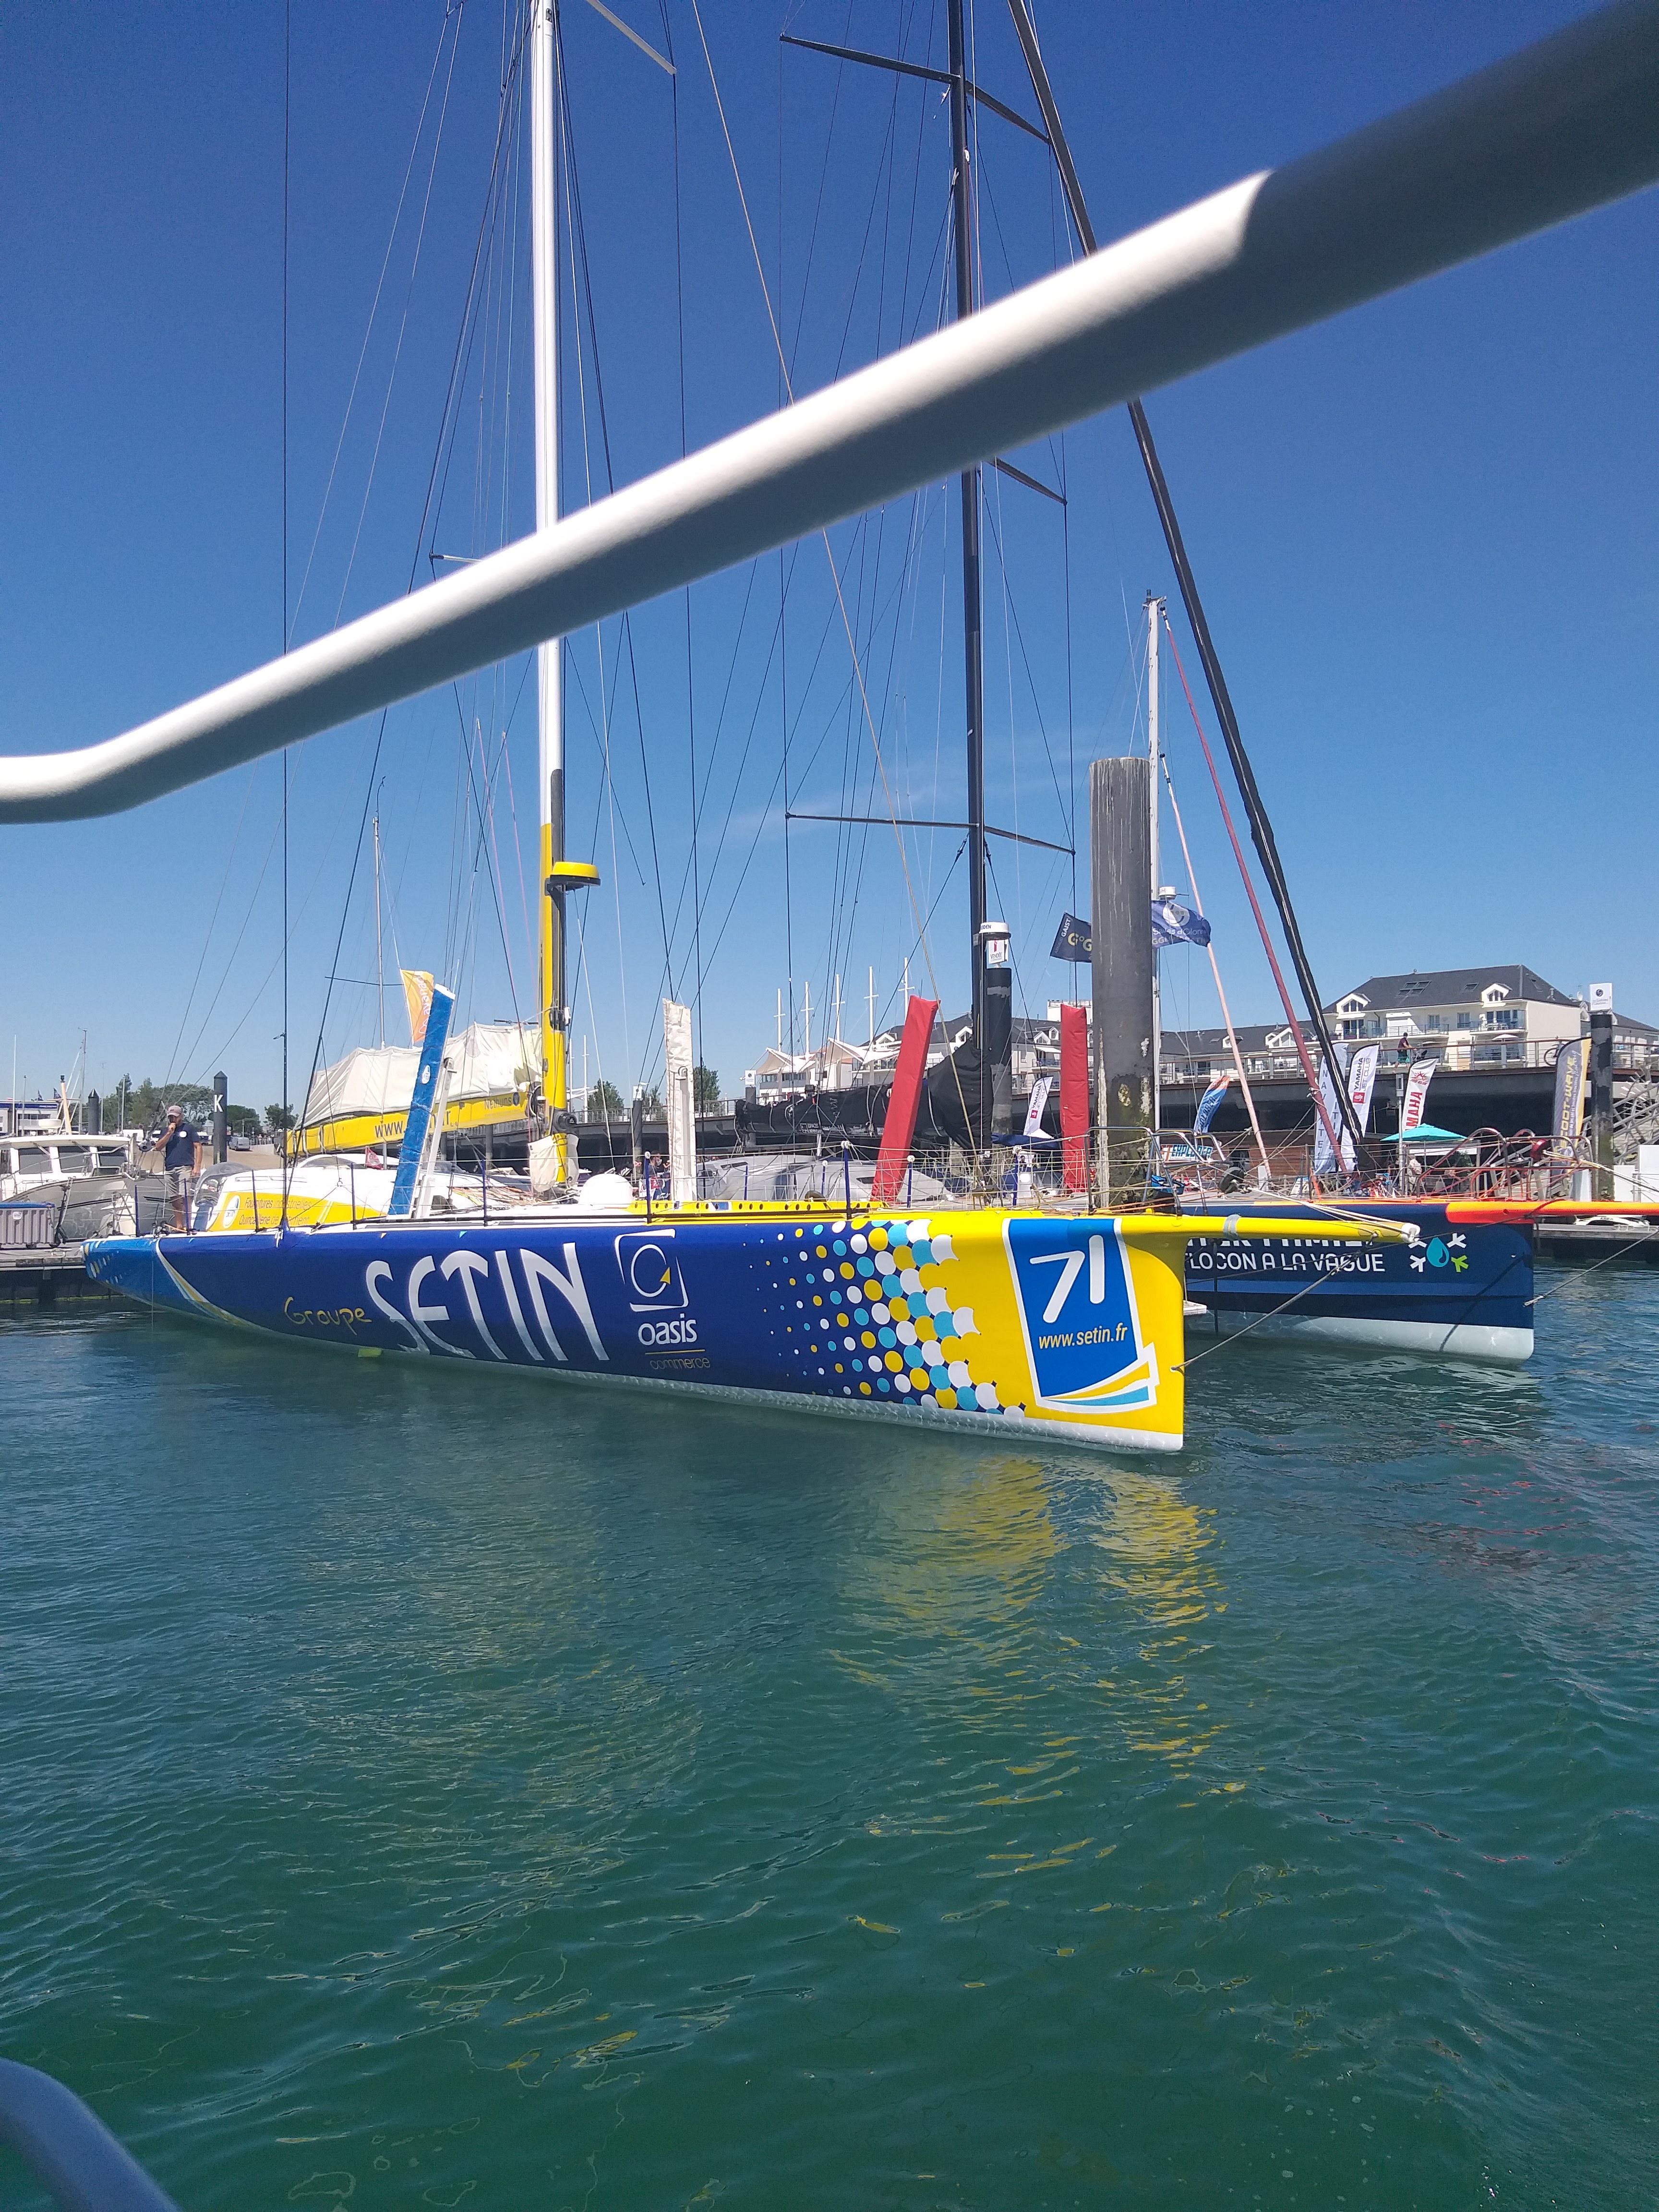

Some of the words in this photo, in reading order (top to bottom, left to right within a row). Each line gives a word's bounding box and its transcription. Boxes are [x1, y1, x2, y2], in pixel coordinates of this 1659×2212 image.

[1061, 918, 1071, 937] GAIST
[1354, 1057, 1364, 1090] YAMAHA
[214, 1094, 224, 1112] K
[1032, 1085, 1042, 1109] YAMAHA
[1405, 1092, 1423, 1131] MAHA
[245, 1197, 273, 1208] Founitures
[274, 1200, 312, 1210] indstrielles
[239, 1214, 270, 1225] Quincallerie
[1281, 1252, 1307, 1271] LA
[1309, 1253, 1386, 1273] VAGUE
[1030, 1235, 1105, 1323] 71
[366, 1242, 610, 1361] SETIN
[284, 1296, 373, 1335] Groupe
[638, 1313, 697, 1346] oasis
[1038, 1322, 1128, 1350] www.setin.fr
[650, 1357, 711, 1370] commerce
